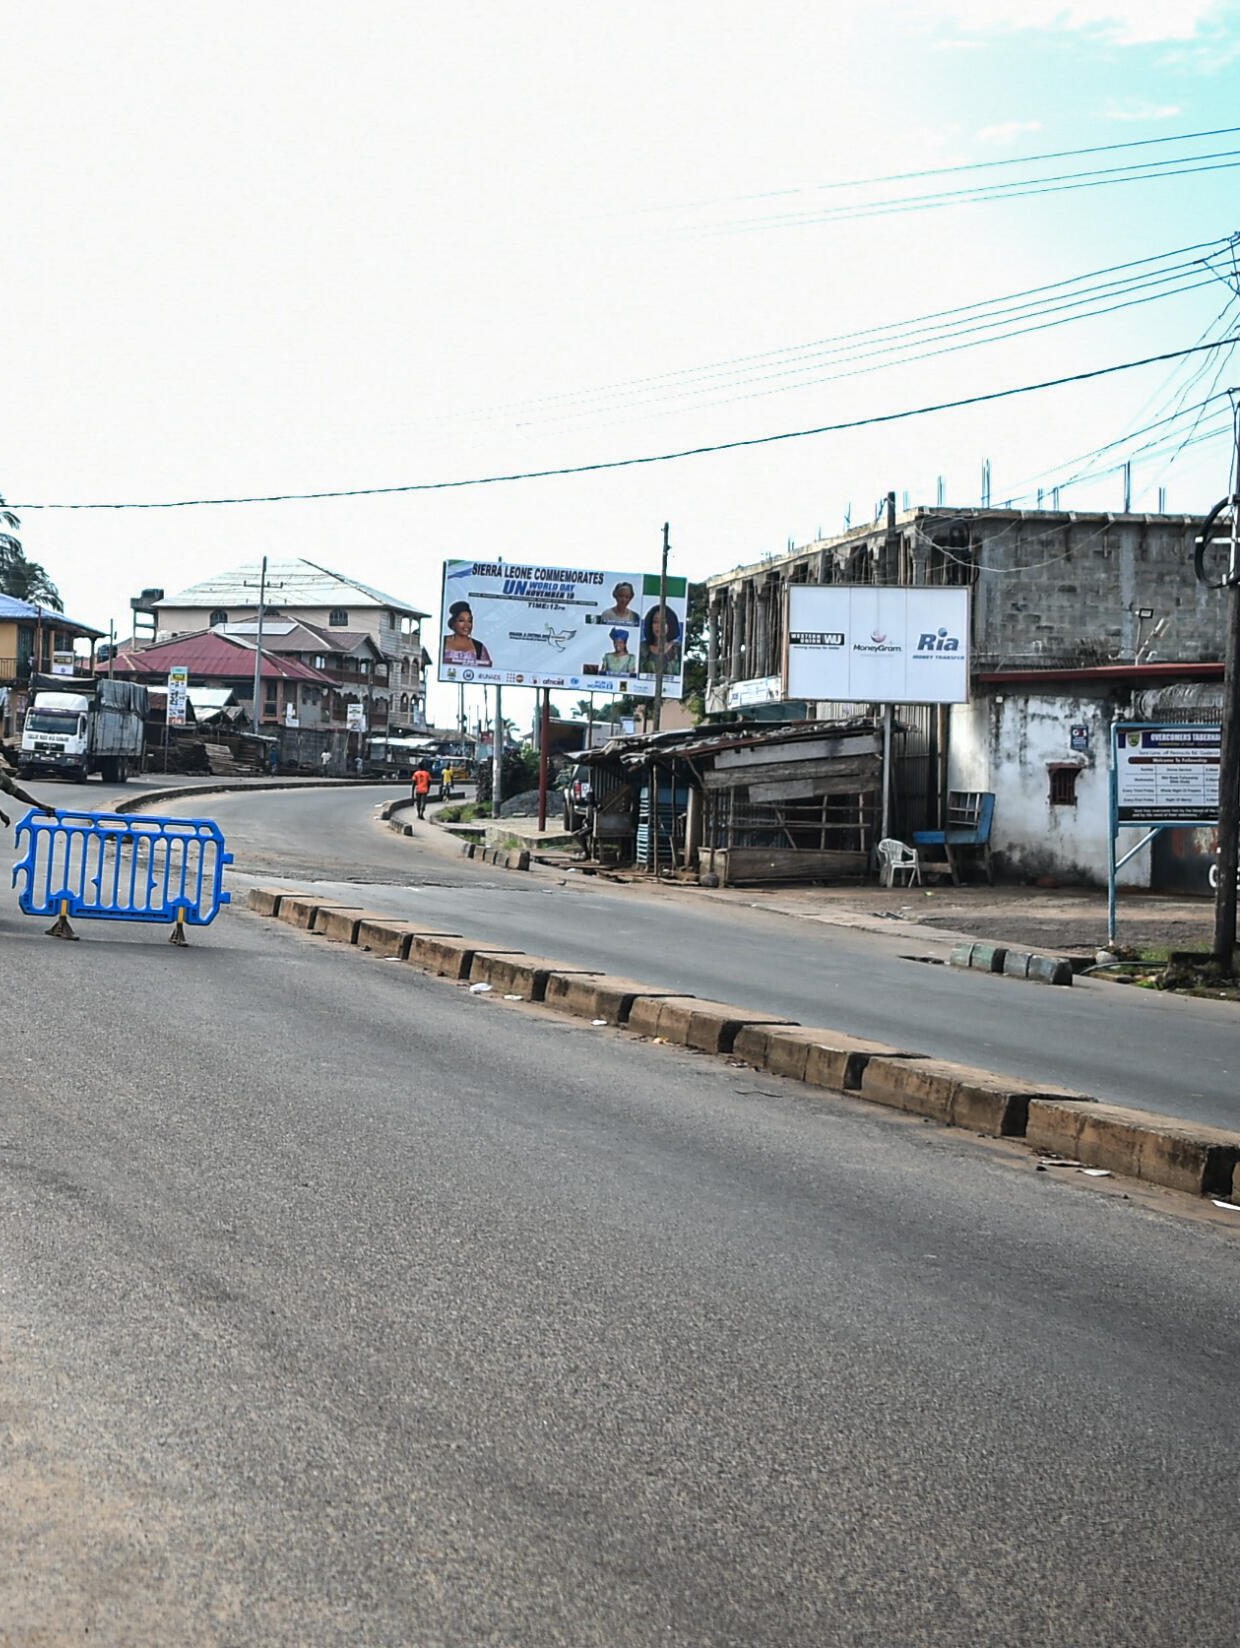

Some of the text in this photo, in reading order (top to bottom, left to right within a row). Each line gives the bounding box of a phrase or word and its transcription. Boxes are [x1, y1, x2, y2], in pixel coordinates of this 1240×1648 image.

[472, 563, 604, 584] SIERRA LEONE COMMEMORATES
[503, 580, 528, 595] UN
[529, 582, 558, 591] WORLD
[526, 590, 564, 598] NOVEMBER
[824, 634, 841, 644] WU
[917, 627, 959, 651] Ria
[853, 644, 901, 652] MoneyGram
